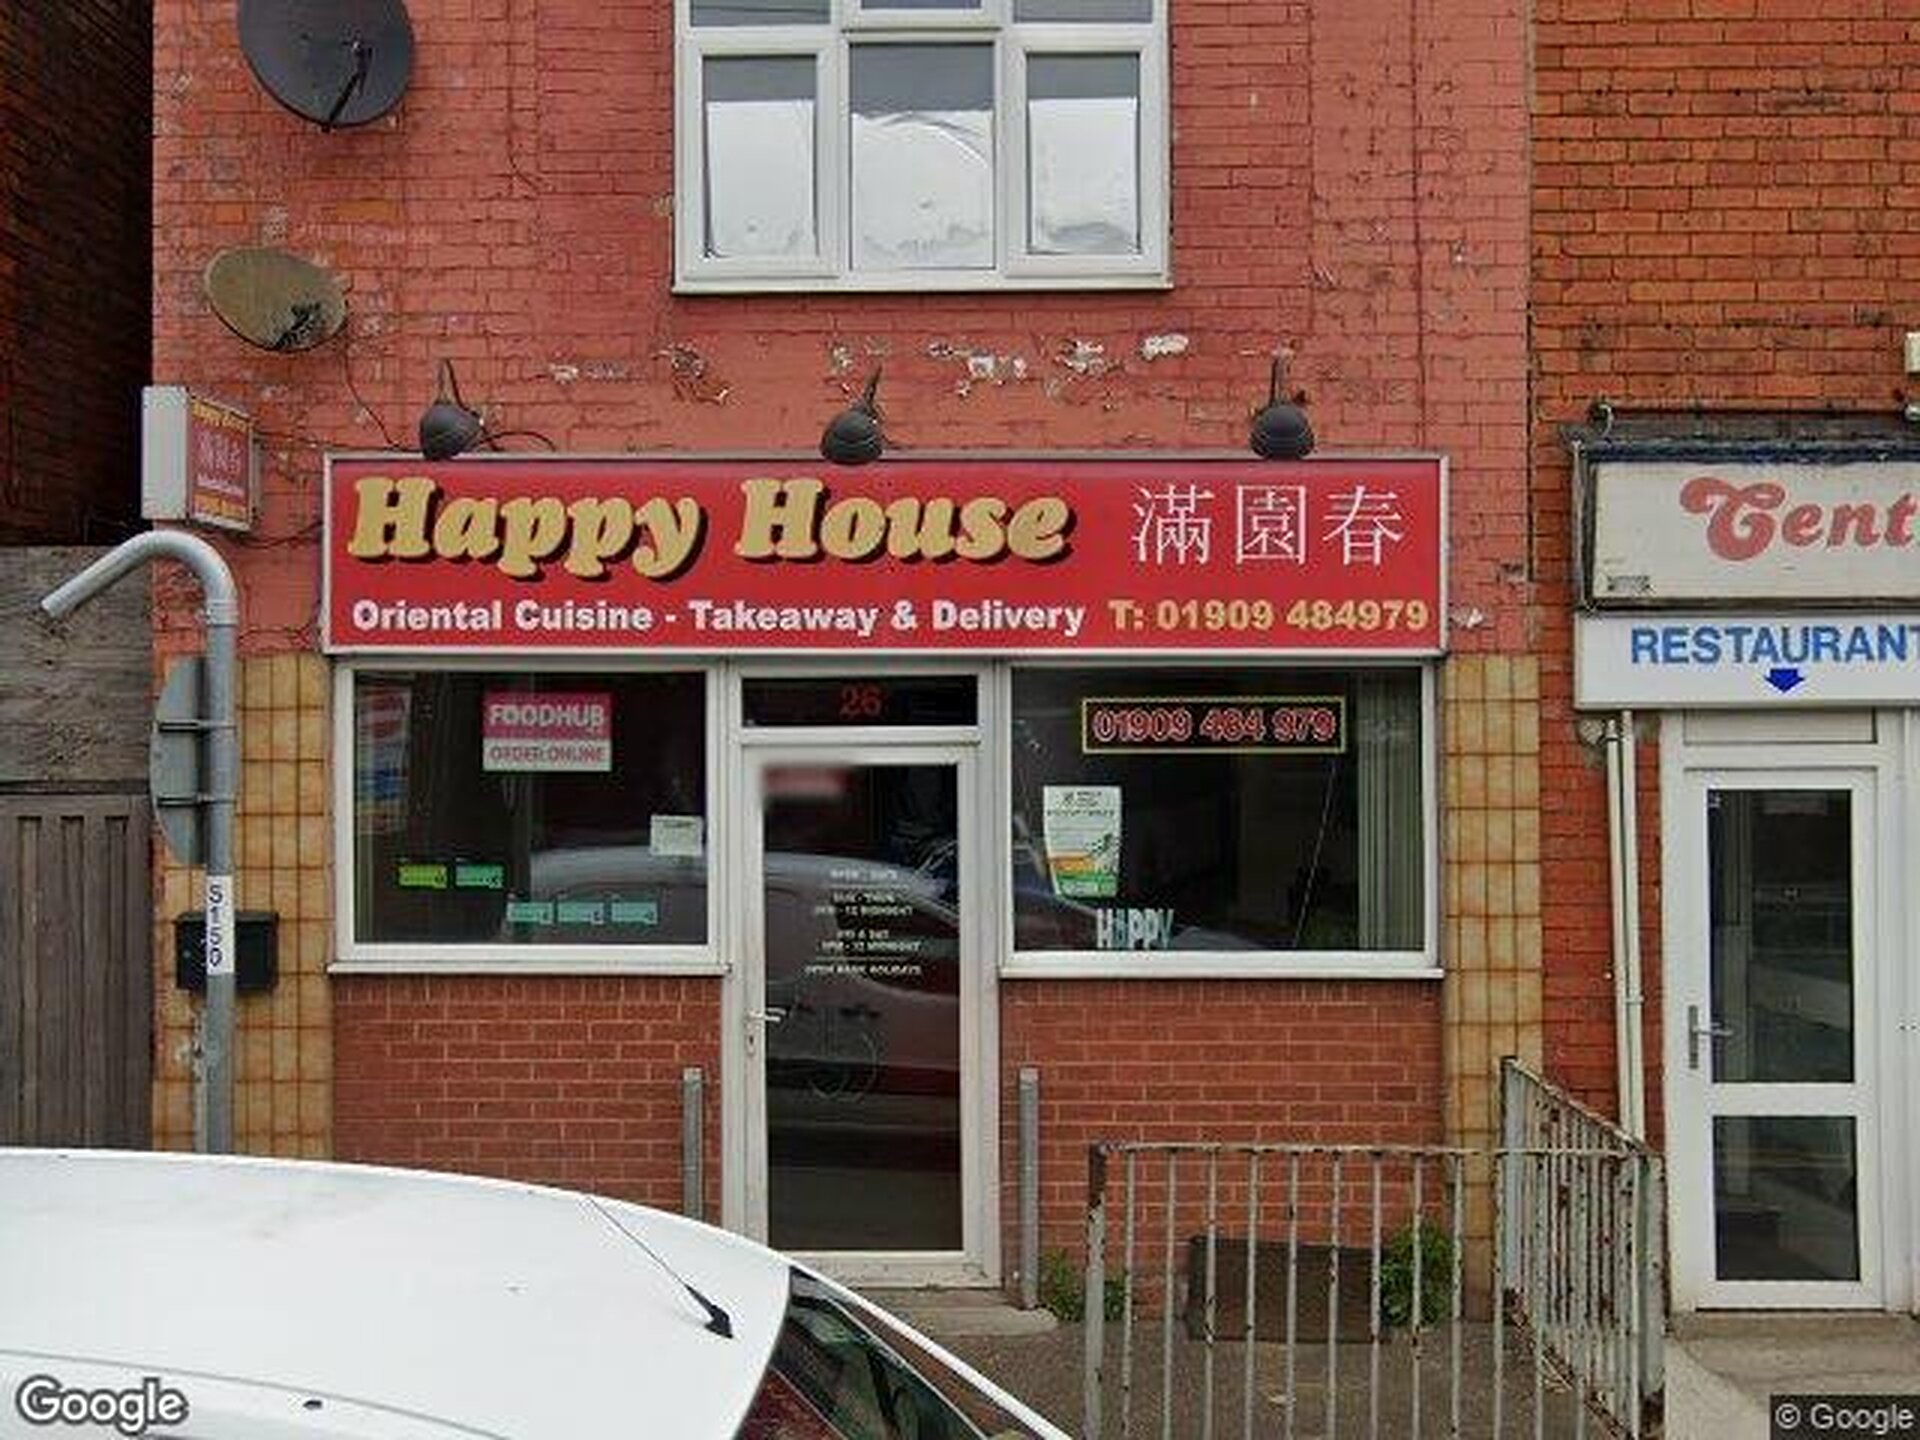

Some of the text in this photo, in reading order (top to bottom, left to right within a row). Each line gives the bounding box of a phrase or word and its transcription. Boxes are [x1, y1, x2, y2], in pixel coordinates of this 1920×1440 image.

[347, 476, 1073, 580] Happy House
[1131, 483, 1402, 566] 滿園春
[353, 599, 502, 631] Oriental
[515, 599, 653, 631] Cuisine
[689, 599, 879, 637] Takeaway
[891, 600, 918, 631] &
[932, 599, 1086, 637] Delivery
[1108, 600, 1429, 631] T: 01909 484979
[489, 703, 606, 728] FOODHUB
[840, 683, 882, 720] 26
[1091, 707, 1193, 742] 01909
[1199, 707, 1266, 741] 484
